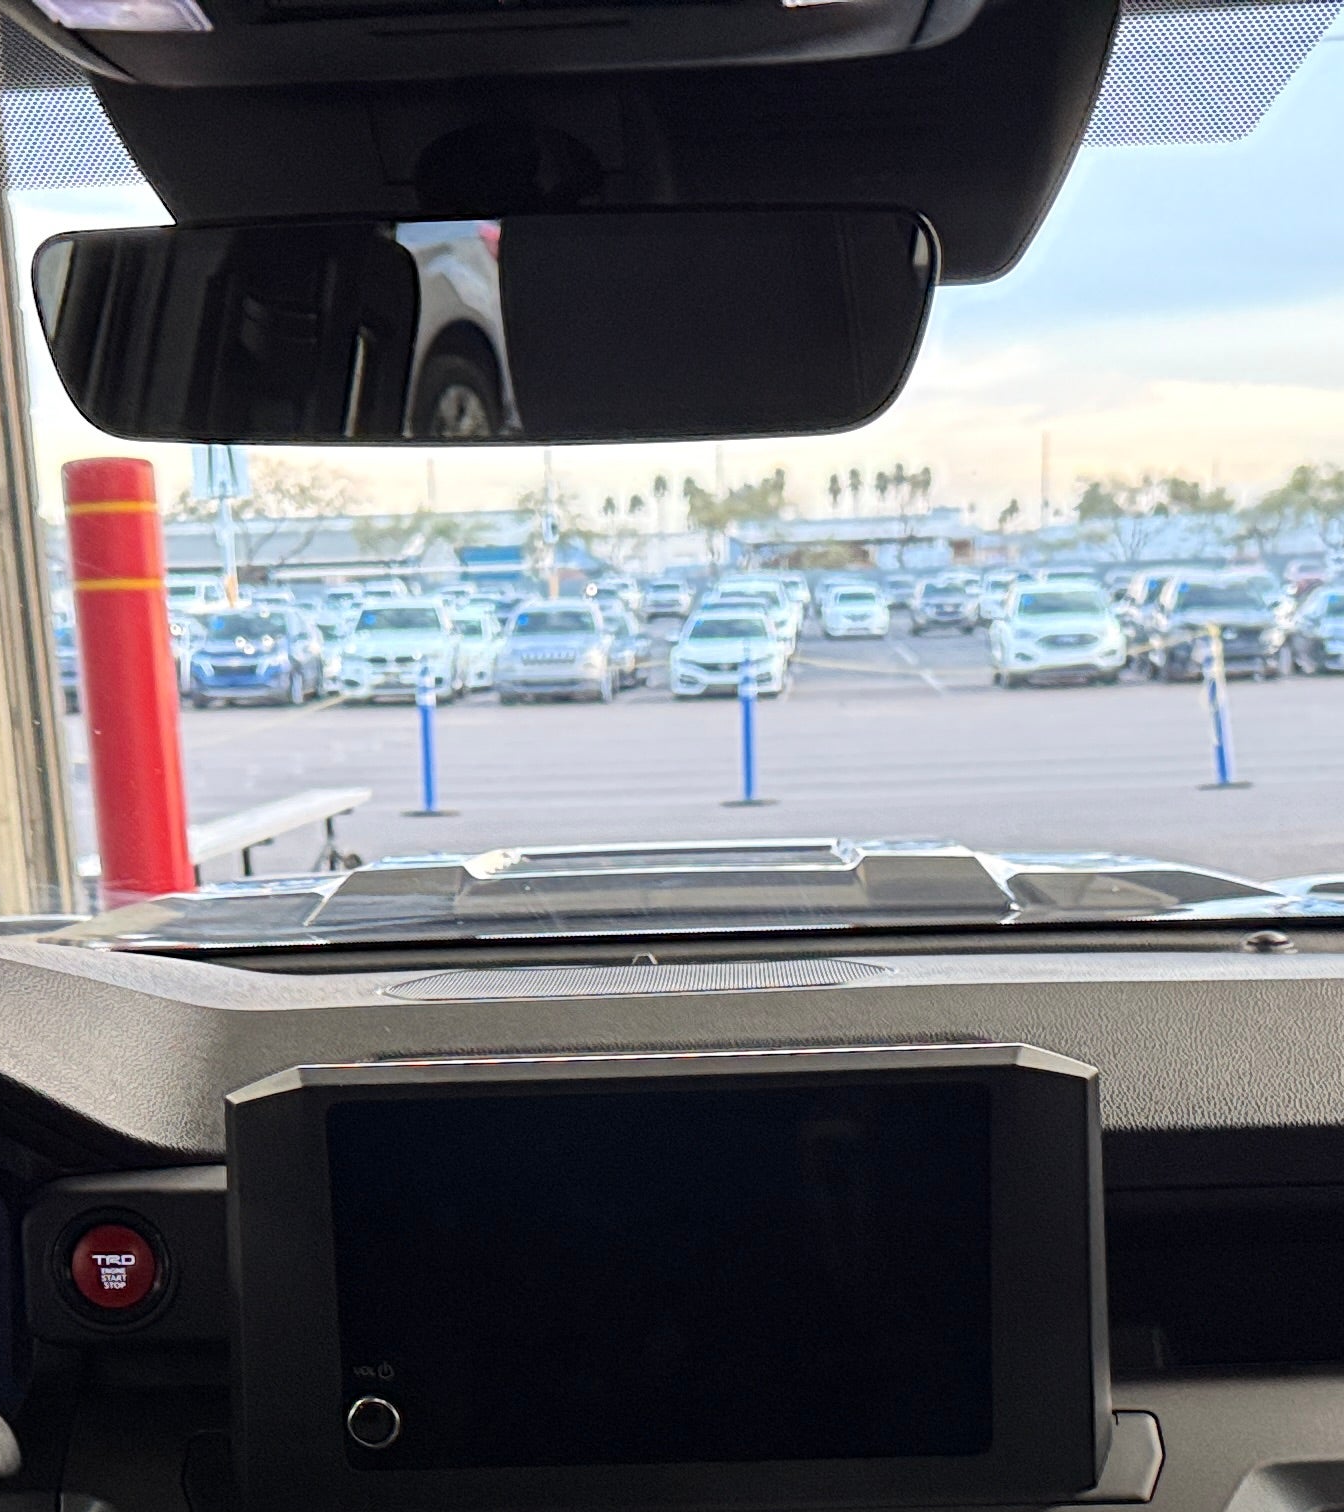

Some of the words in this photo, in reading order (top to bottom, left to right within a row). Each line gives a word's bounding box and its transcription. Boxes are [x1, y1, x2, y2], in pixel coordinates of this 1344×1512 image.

[91, 1254, 136, 1265] TRD
[100, 1274, 127, 1282] START
[103, 1281, 127, 1290] STOP
